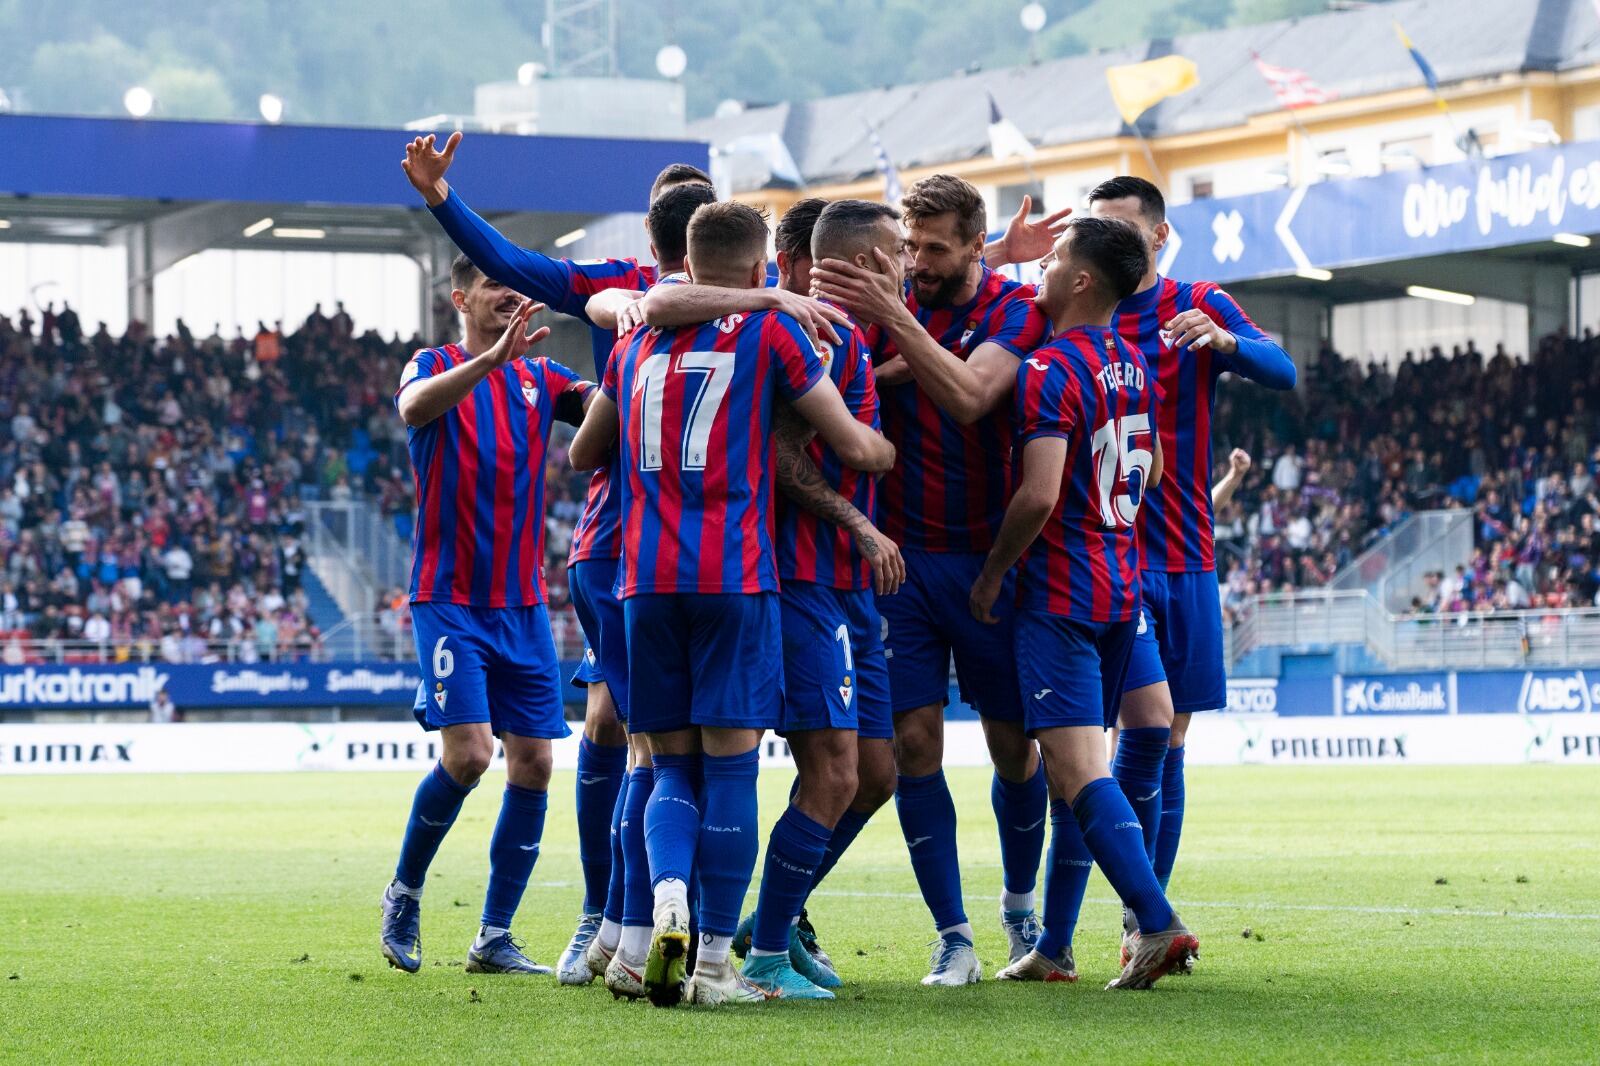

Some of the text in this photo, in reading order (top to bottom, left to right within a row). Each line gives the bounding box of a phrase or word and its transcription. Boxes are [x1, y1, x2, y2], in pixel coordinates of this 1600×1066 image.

[632, 351, 736, 472] 17
[1092, 413, 1152, 528] 15
[433, 636, 454, 679] 6
[1272, 736, 1407, 758] PNEUMAX
